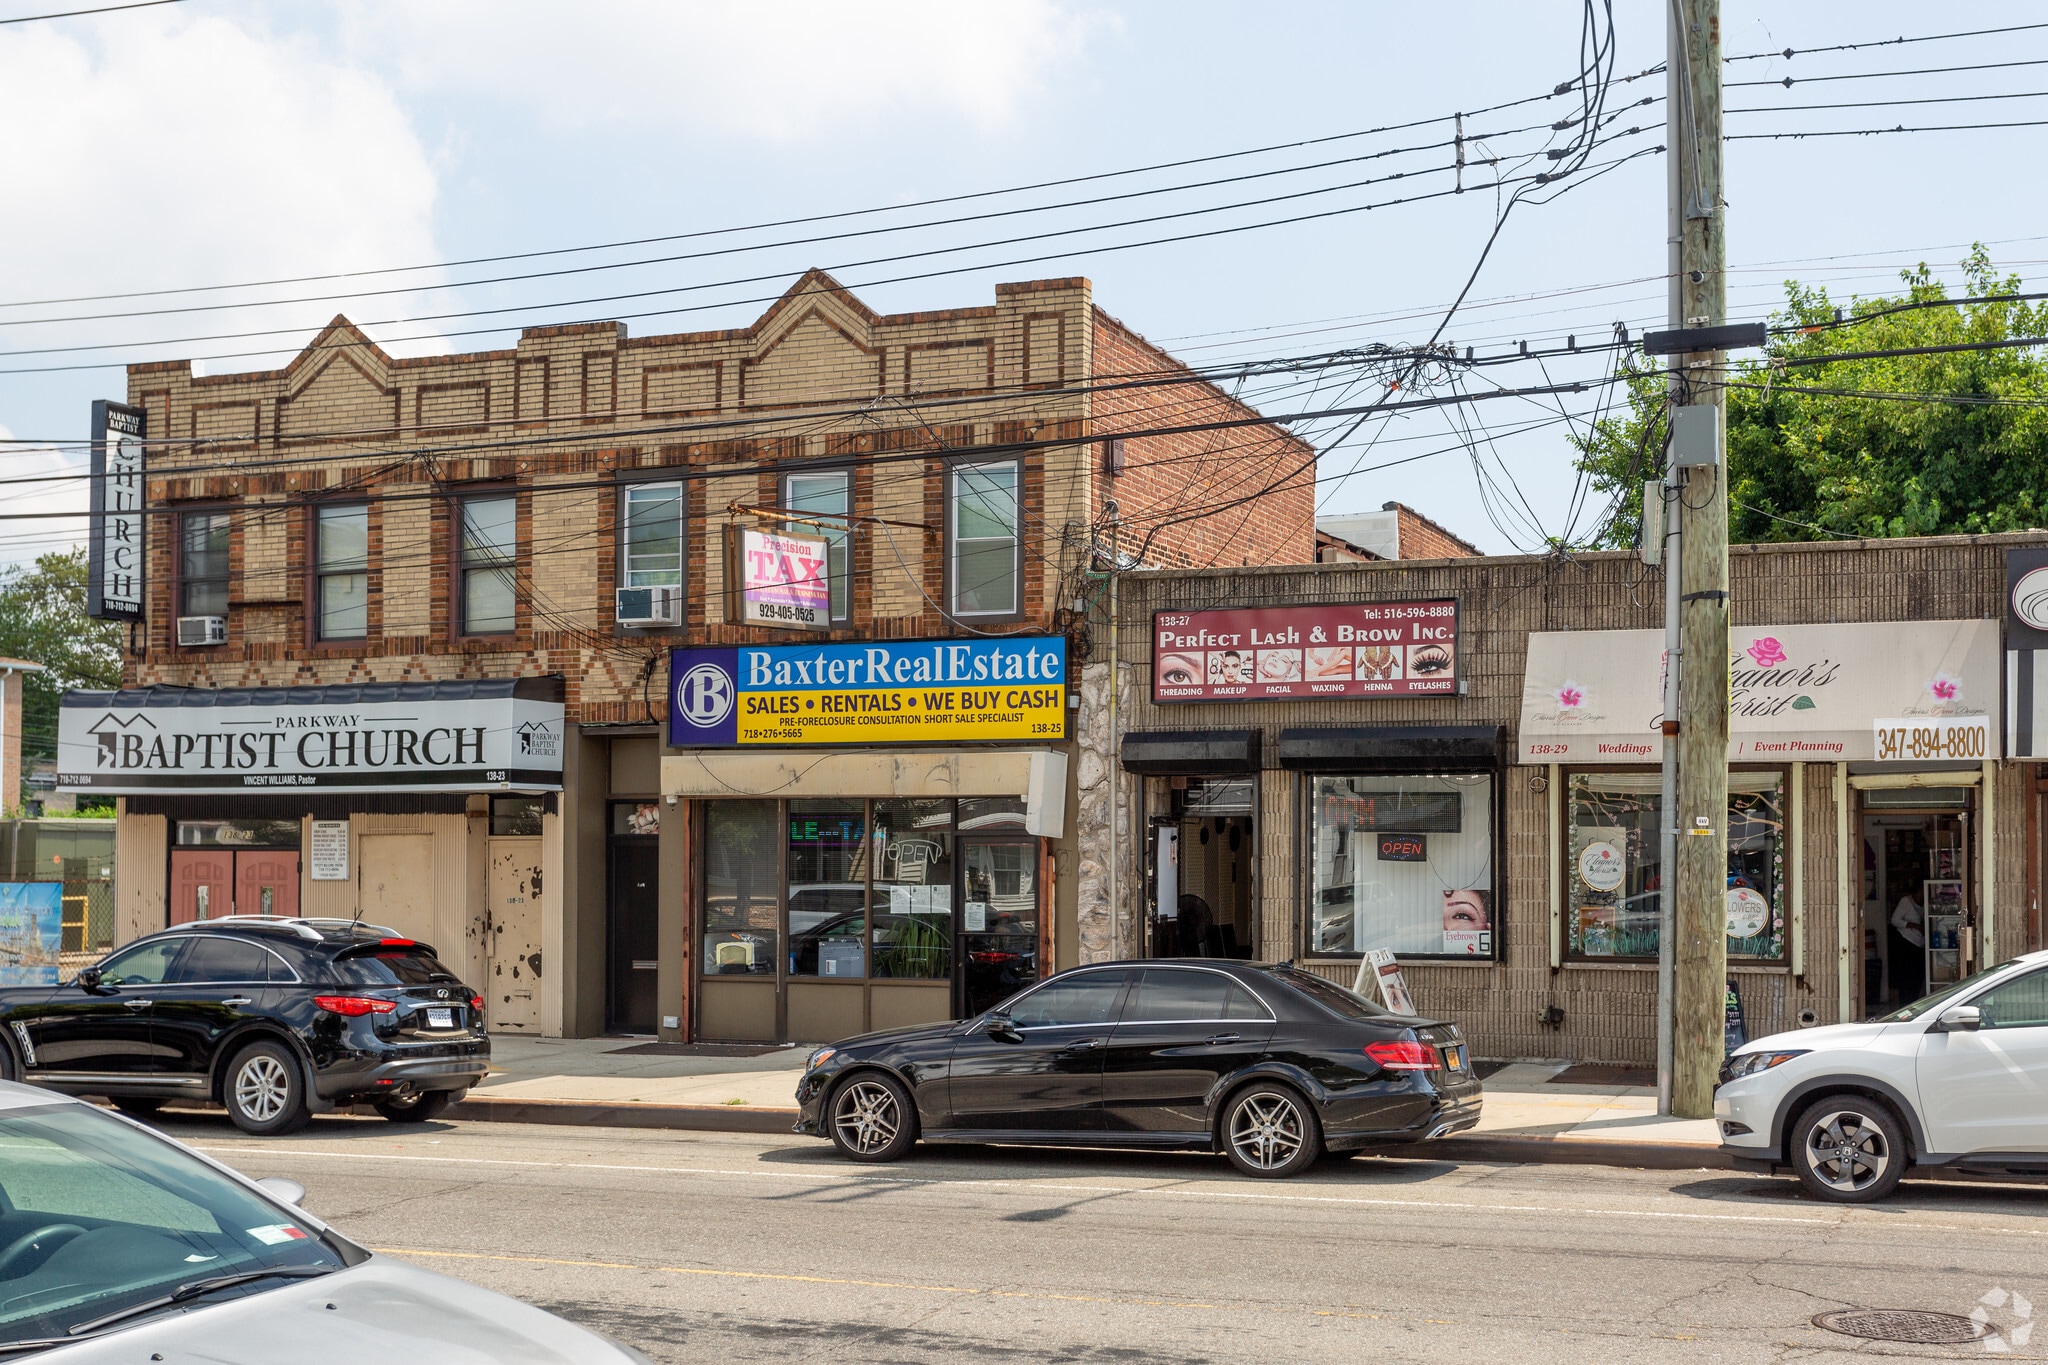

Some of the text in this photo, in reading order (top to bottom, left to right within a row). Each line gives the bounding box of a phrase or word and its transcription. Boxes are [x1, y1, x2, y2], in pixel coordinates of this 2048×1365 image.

[108, 410, 140, 425] PARKWAY
[109, 419, 139, 433] BAPTIST
[112, 437, 135, 598] CHURCH
[762, 536, 812, 555] Precision
[748, 550, 826, 588] TAX
[759, 603, 815, 622] 929-405-0525
[1364, 606, 1454, 619] Tel: 516-596-8880
[1160, 616, 1190, 626] 138-27
[1309, 625, 1328, 643] &
[1160, 687, 1203, 696] THREADING
[1266, 685, 1291, 694] FACIAL
[1311, 684, 1345, 692] WAXING
[1364, 682, 1393, 691] HENNA
[1409, 681, 1451, 690] EYELASHES
[746, 690, 1059, 714] SALES RENTALS WE BUY CASH
[275, 715, 360, 729] PARKWAY
[779, 712, 1025, 727] PRE-FORECLOSURE CONSULTATION SHORT SALE SPECIALIST
[1031, 723, 1062, 734] 138-25
[531, 733, 561, 741] PARKWAY
[1878, 725, 1986, 760] 347-894-8800
[120, 727, 487, 768] BAPTIST CHURCH
[531, 740, 556, 749] BAPTIST
[1530, 744, 1568, 754] 138-29
[1598, 741, 1844, 755] Weddings Event Planning
[531, 747, 557, 757] CHURCH
[59, 774, 79, 784] 718-712
[244, 775, 316, 786] VINCENT WILLIAMS, Pastor
[486, 771, 506, 781] 138-23
[887, 843, 940, 864] OPEN
[1382, 842, 1422, 855] OPEN
[1727, 902, 1762, 913] LOWERS
[1446, 931, 1477, 943] Eyebrows
